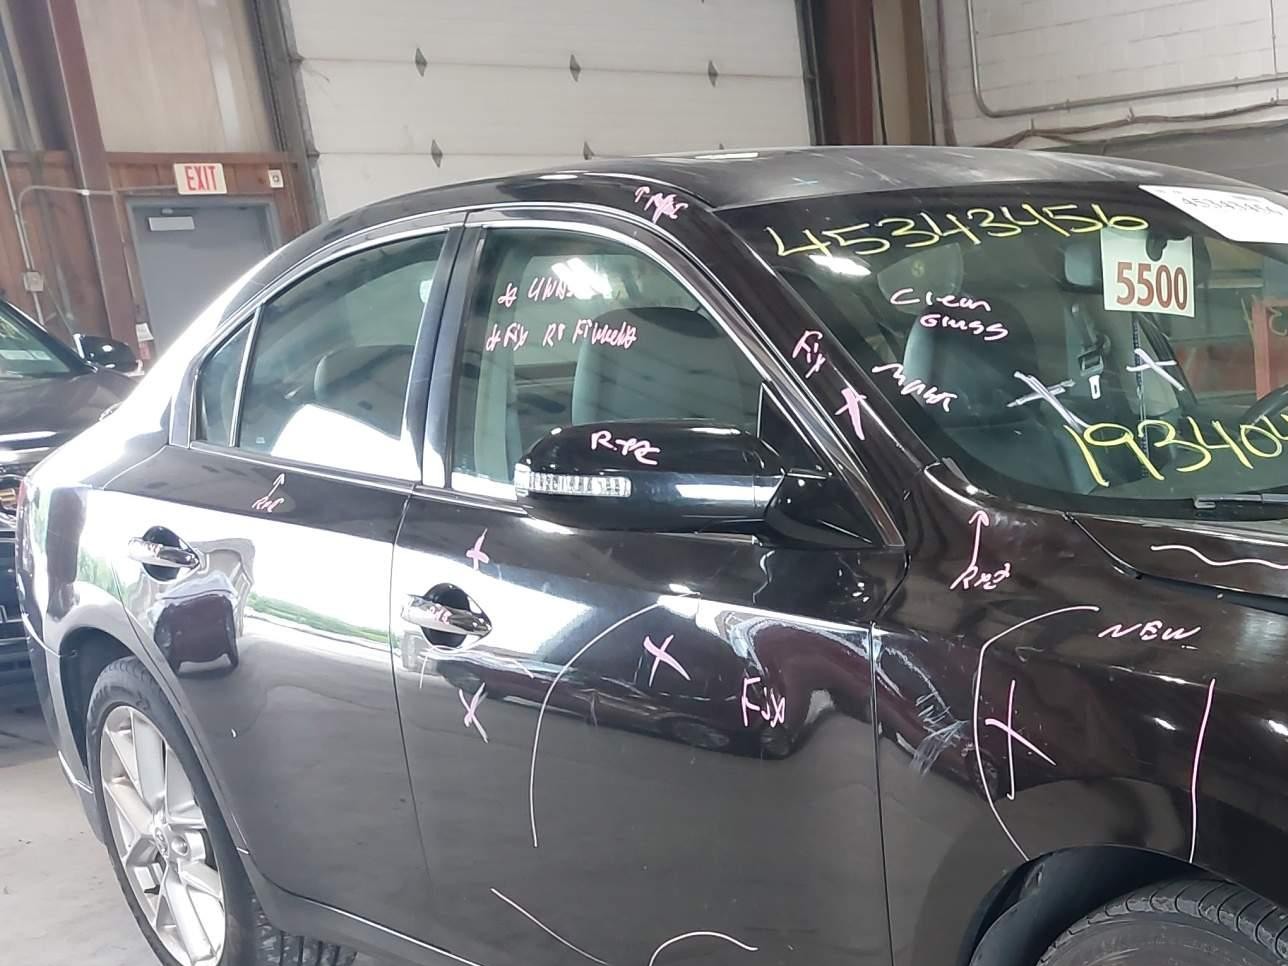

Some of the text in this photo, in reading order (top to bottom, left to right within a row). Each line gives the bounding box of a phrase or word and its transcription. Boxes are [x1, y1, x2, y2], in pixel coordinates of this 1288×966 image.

[184, 165, 217, 191] EXIT
[766, 203, 1149, 257] 45343456
[1116, 261, 1188, 311] 5500
[1098, 620, 1201, 641] NEW
